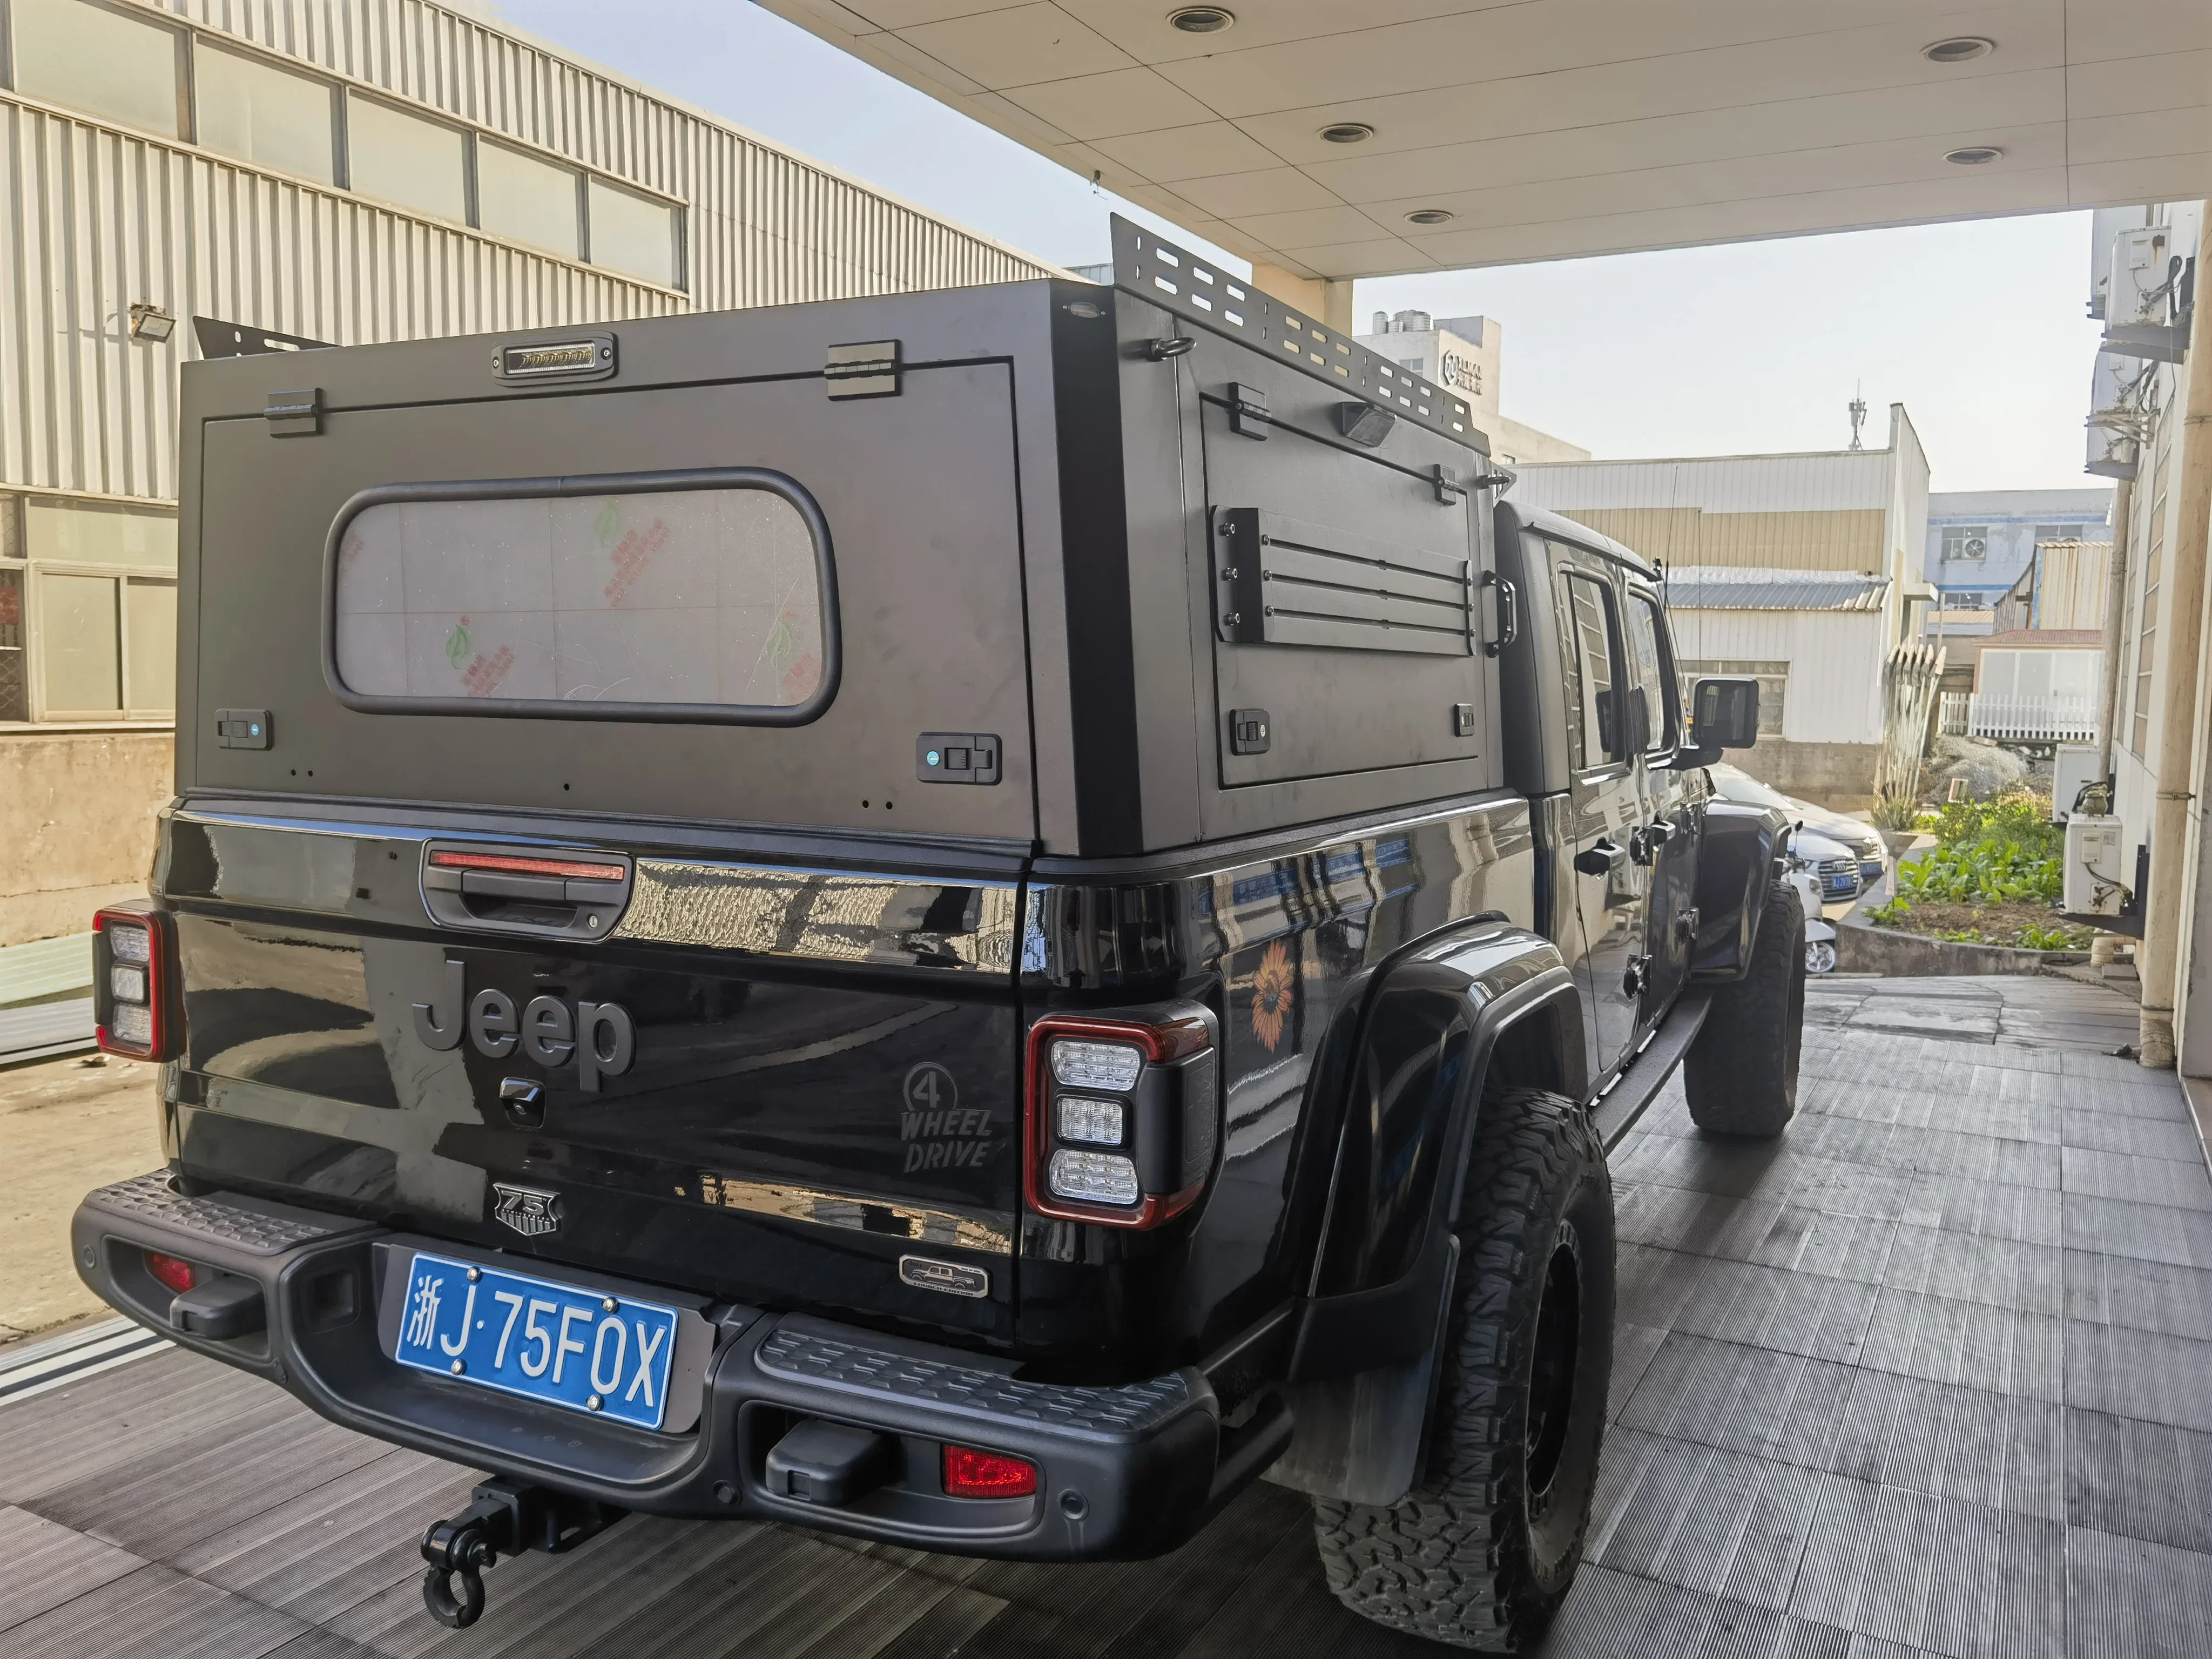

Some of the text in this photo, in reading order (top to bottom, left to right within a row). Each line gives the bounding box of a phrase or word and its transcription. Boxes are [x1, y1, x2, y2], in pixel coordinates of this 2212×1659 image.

[412, 959, 637, 1094] Jeep
[912, 1071, 940, 1108] 4
[901, 1110, 993, 1141] WHEEL
[904, 1141, 992, 1173] DRIVE
